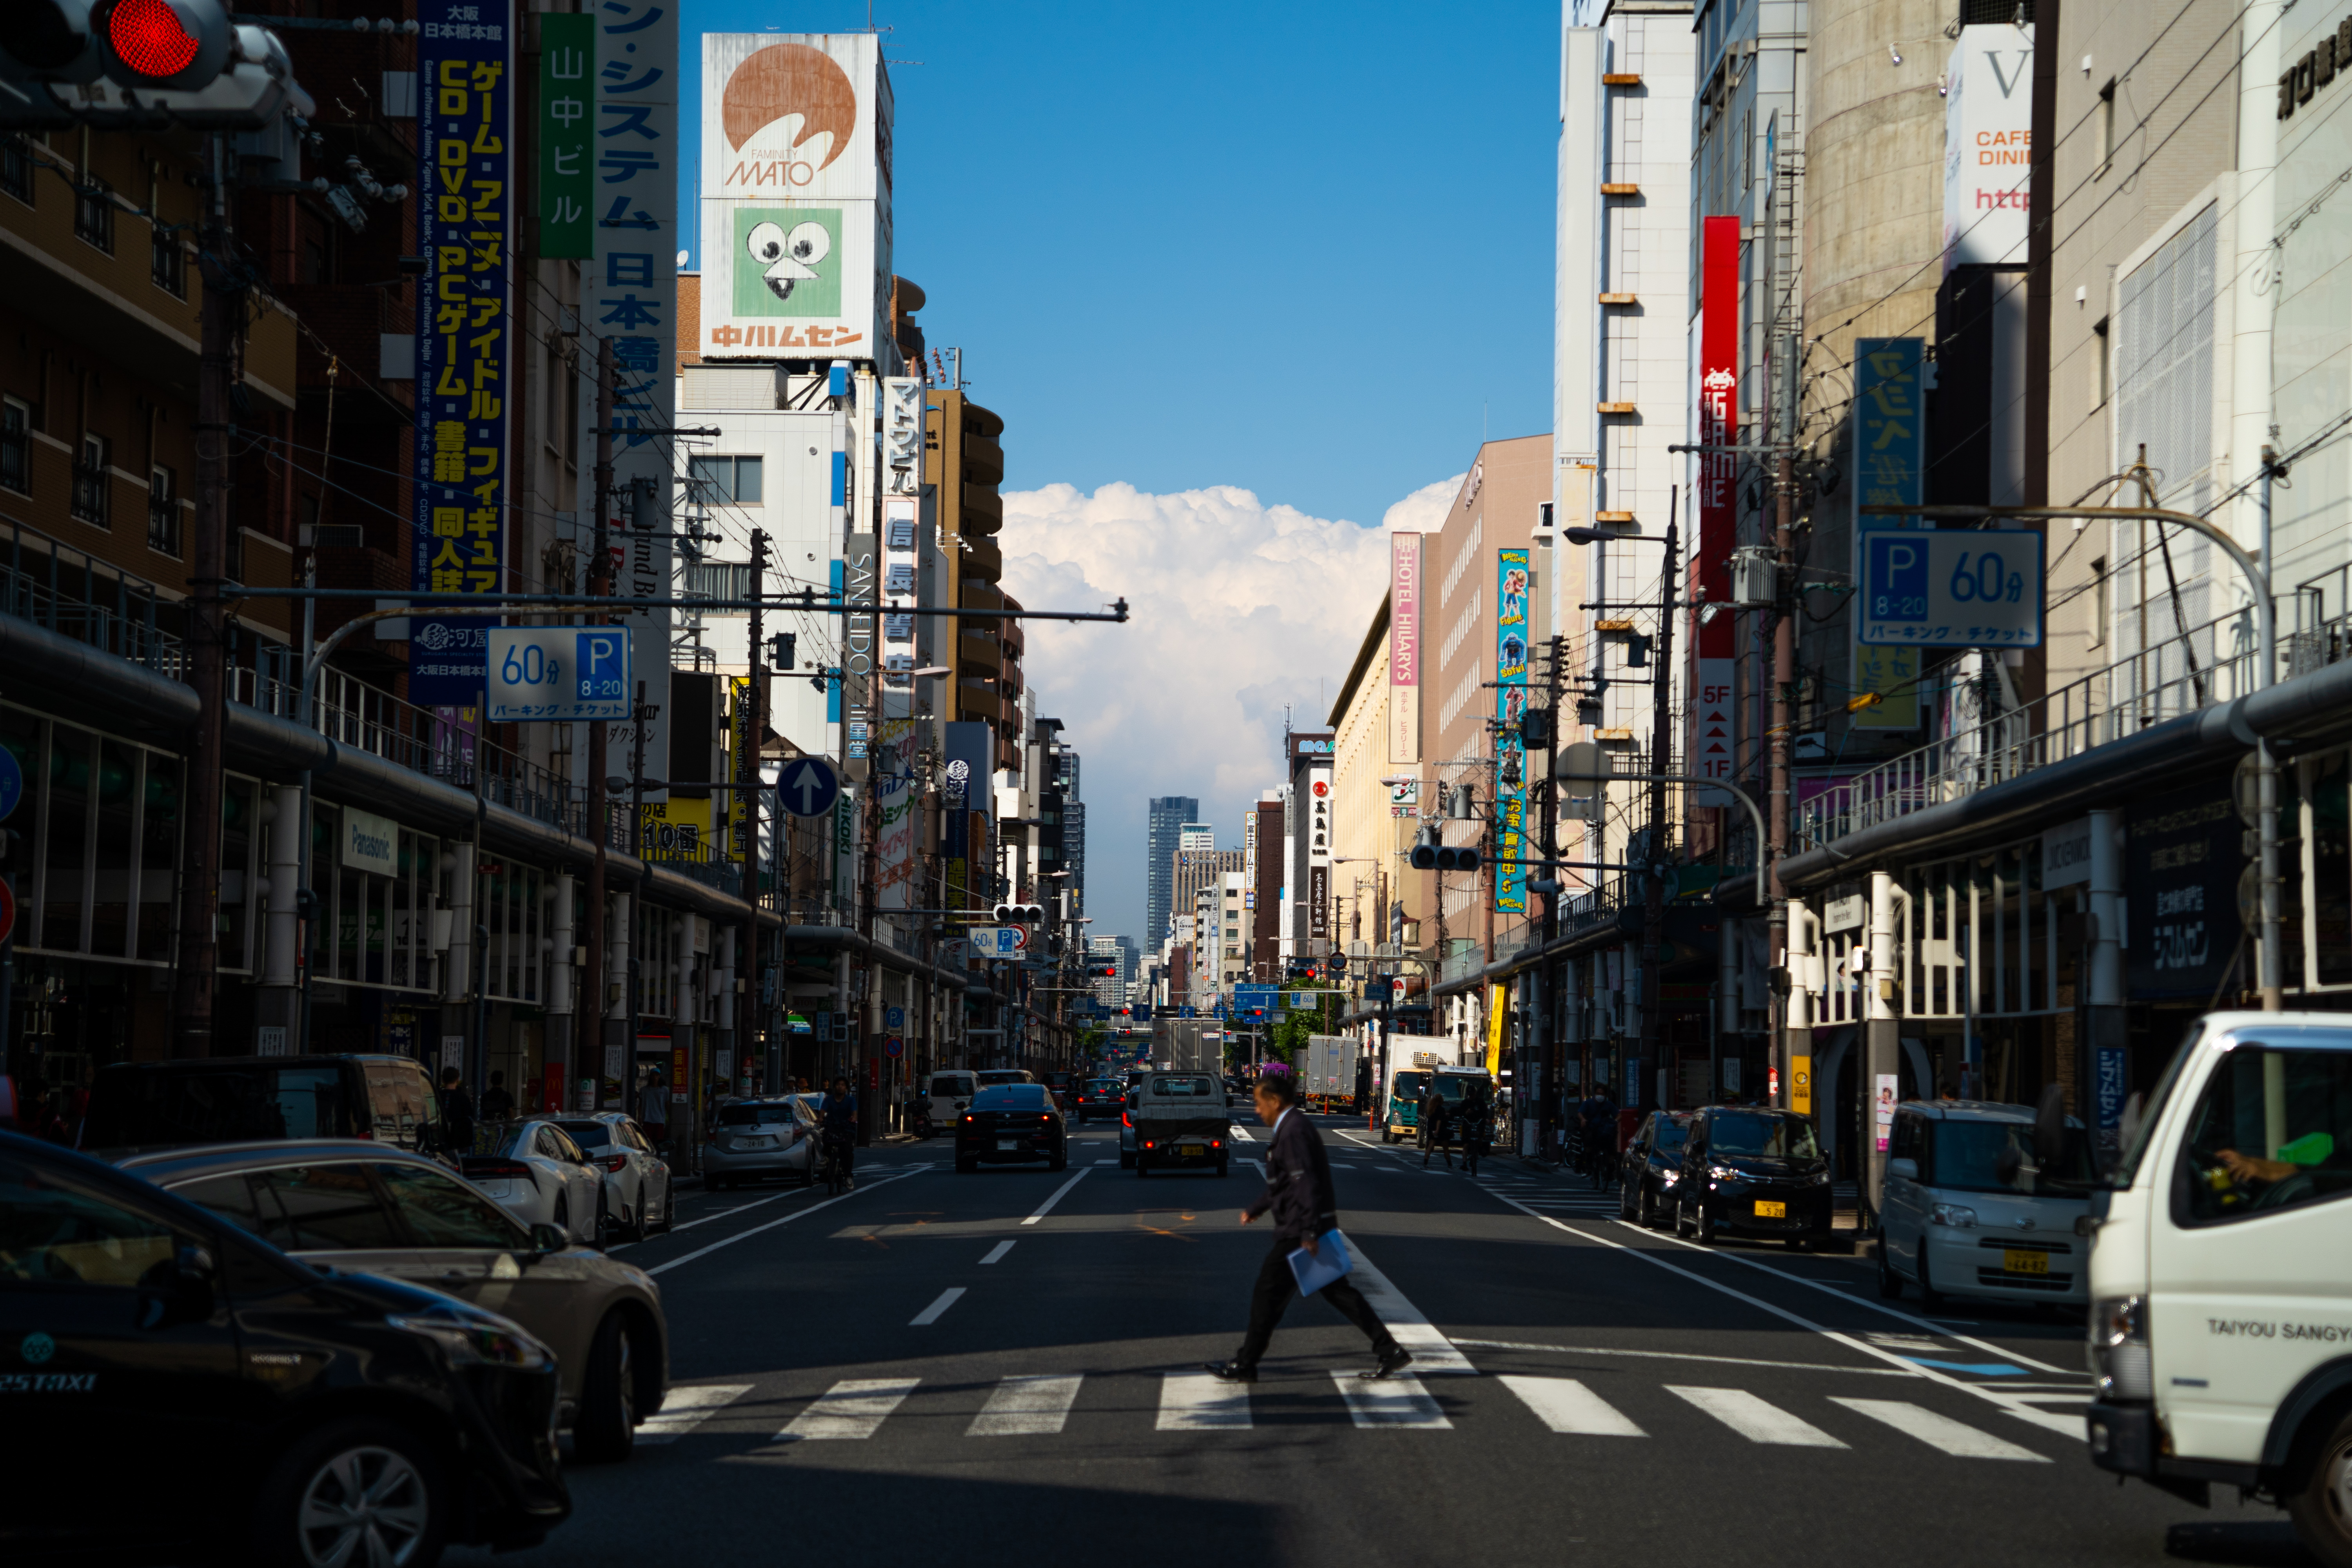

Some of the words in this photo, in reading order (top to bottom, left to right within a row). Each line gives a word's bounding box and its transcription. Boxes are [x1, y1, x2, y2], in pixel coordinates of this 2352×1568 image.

[447, 5, 479, 22] 大阪
[424, 22, 502, 41] 日本橋本館
[550, 46, 583, 224] 山中ビル
[751, 149, 798, 160] FAMINITY
[725, 160, 813, 187] MATO
[711, 325, 862, 348] 中川ムセン
[1712, 392, 1734, 508] GAME
[1887, 544, 1916, 589] P
[1398, 557, 1412, 609] HOTEL
[849, 553, 872, 675] SANSEIDO
[1876, 595, 1926, 616] 8-20
[1499, 613, 1523, 626] Figure
[1870, 626, 2033, 641] パーキング・チケット
[590, 639, 613, 675] P
[1397, 613, 1415, 681] HILLARYS
[1500, 664, 1526, 678] Sofvi
[581, 680, 621, 696] 8-20
[1703, 685, 1730, 704] 5F
[494, 704, 623, 716] パーキング・チケット
[1399, 721, 1408, 757] ヒラリーズ
[1706, 760, 1730, 777] 1F
[1314, 800, 1326, 846] 高島屋
[352, 823, 390, 862] Panasonic
[1002, 931, 1010, 943] P
[890, 1011, 897, 1025] P
[2207, 1319, 2277, 1339] TAIYOU
